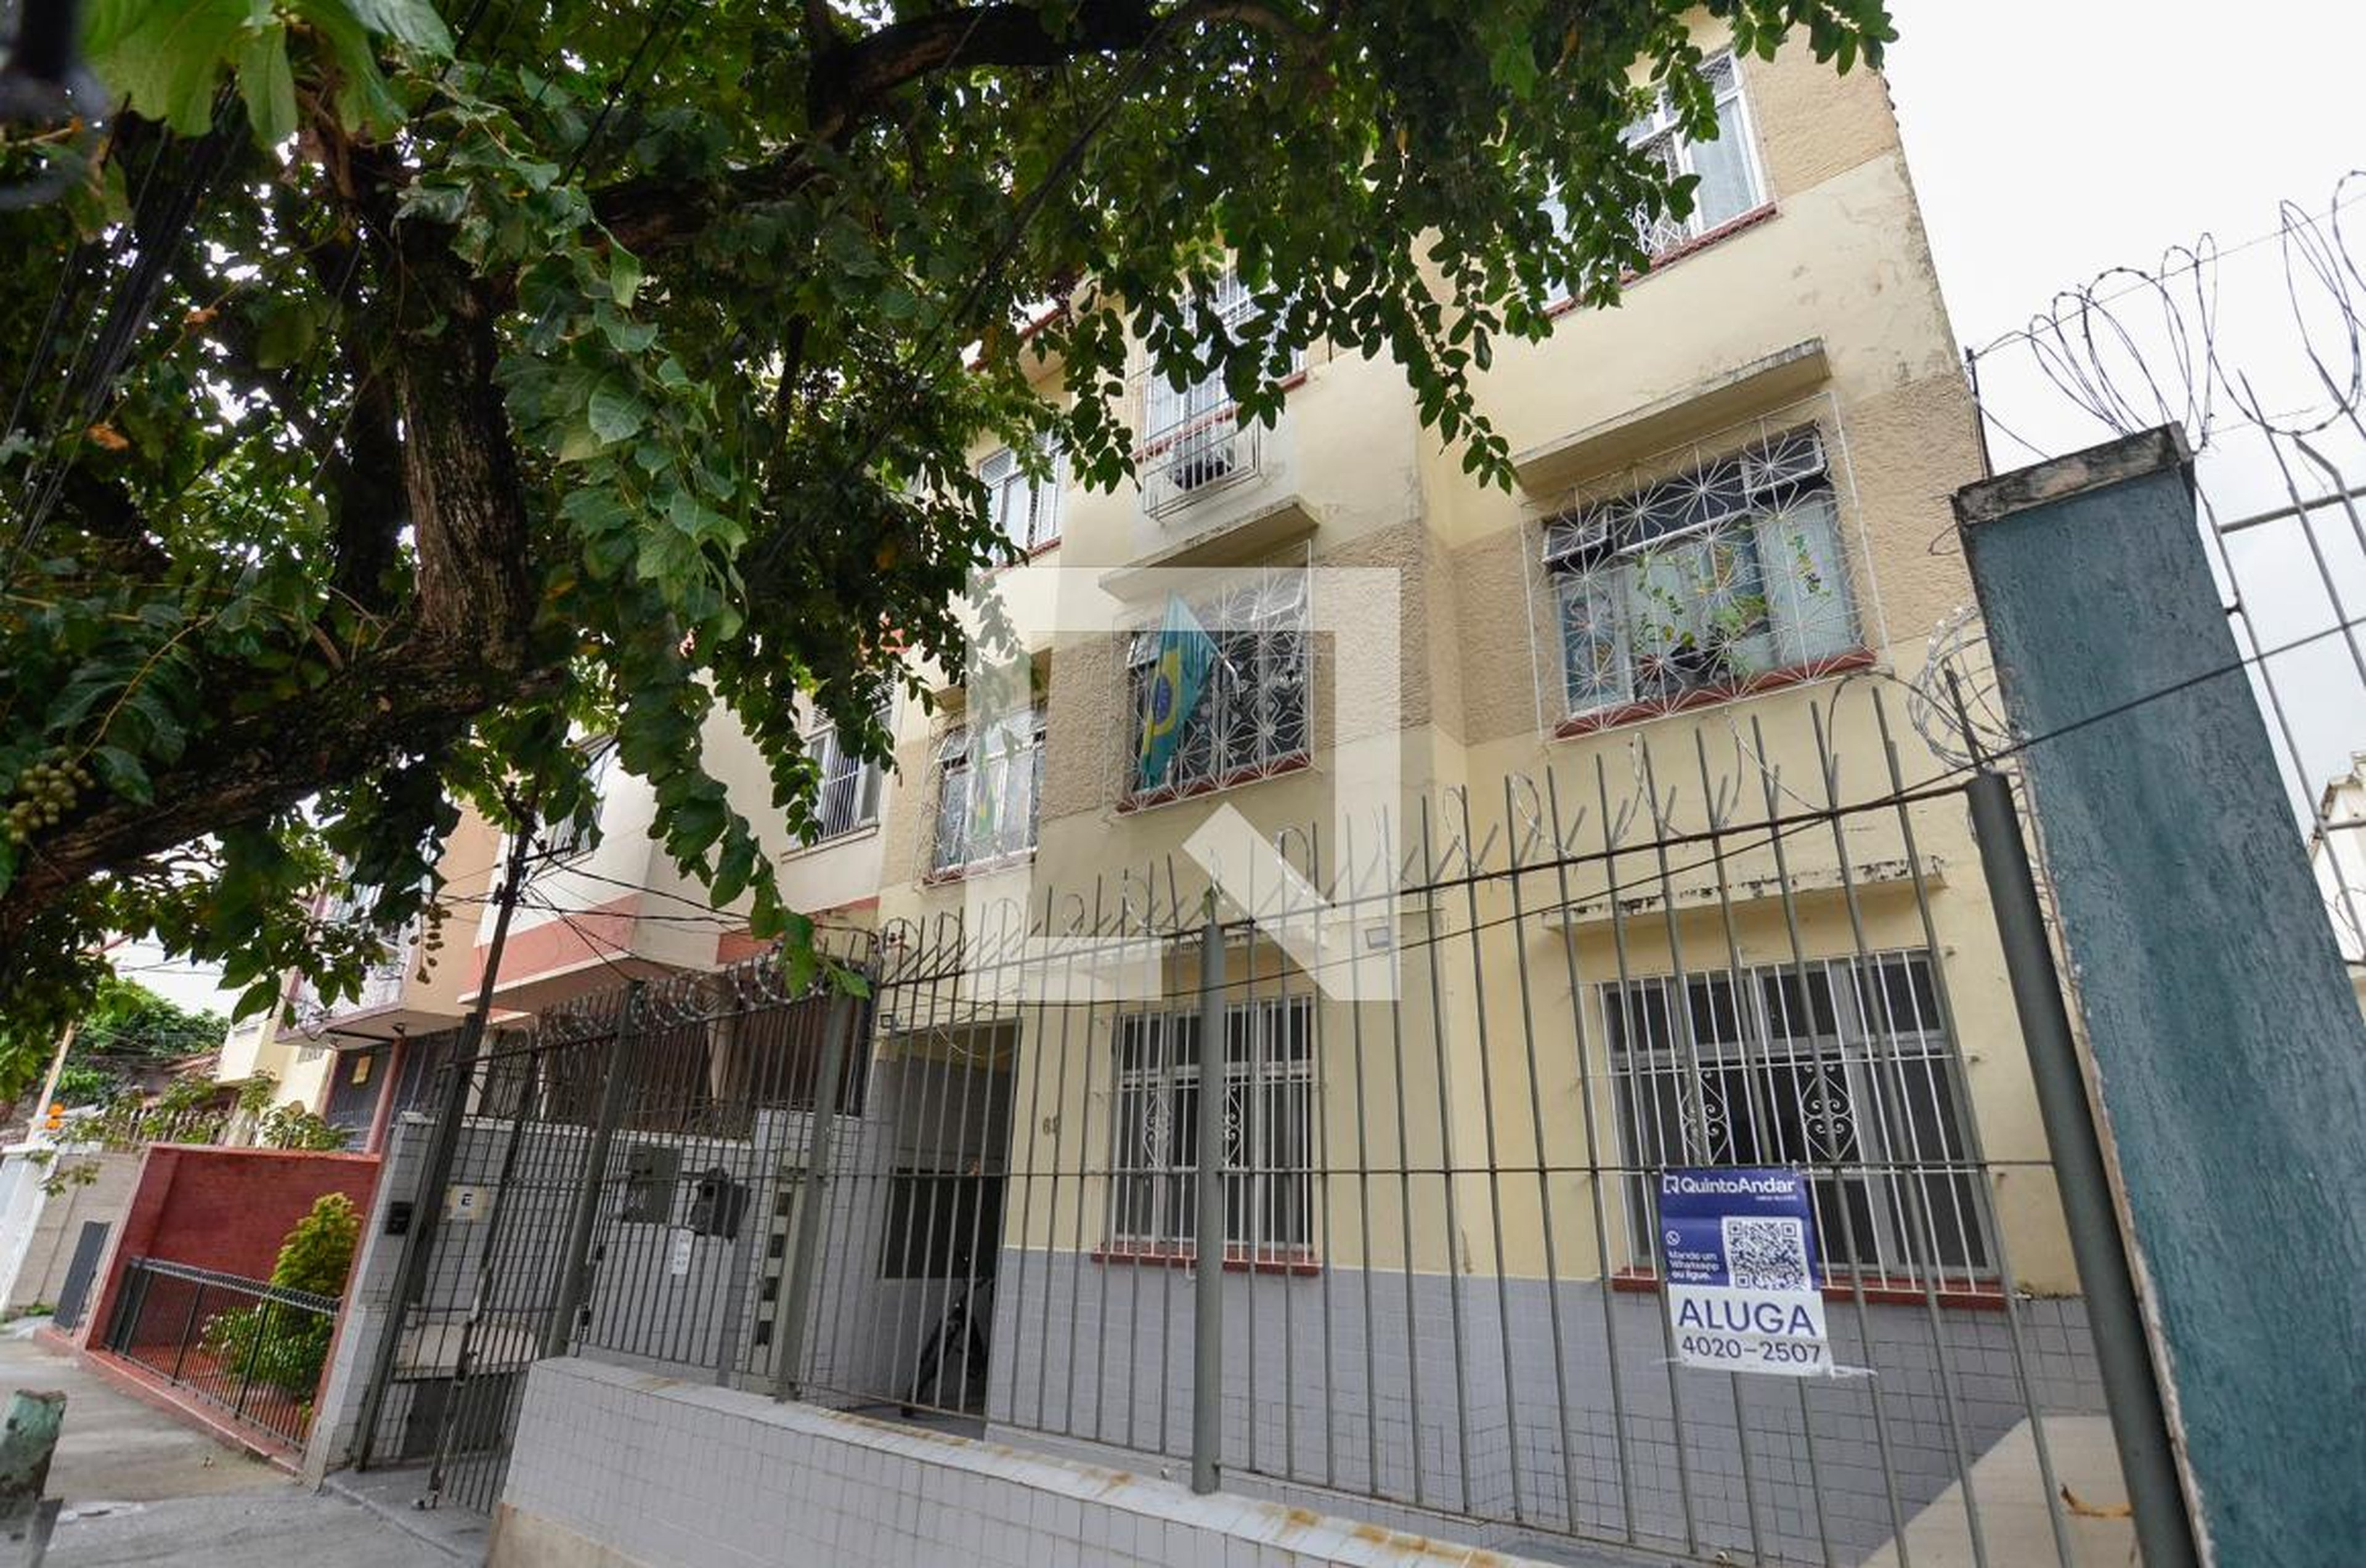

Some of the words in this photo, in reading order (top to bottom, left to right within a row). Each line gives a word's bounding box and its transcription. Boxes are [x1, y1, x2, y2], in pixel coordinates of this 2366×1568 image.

[1680, 1177, 1795, 1193] QuintoAndar
[1678, 1299, 1816, 1336] ALUGA
[1681, 1336, 1821, 1363] 4020-2507
